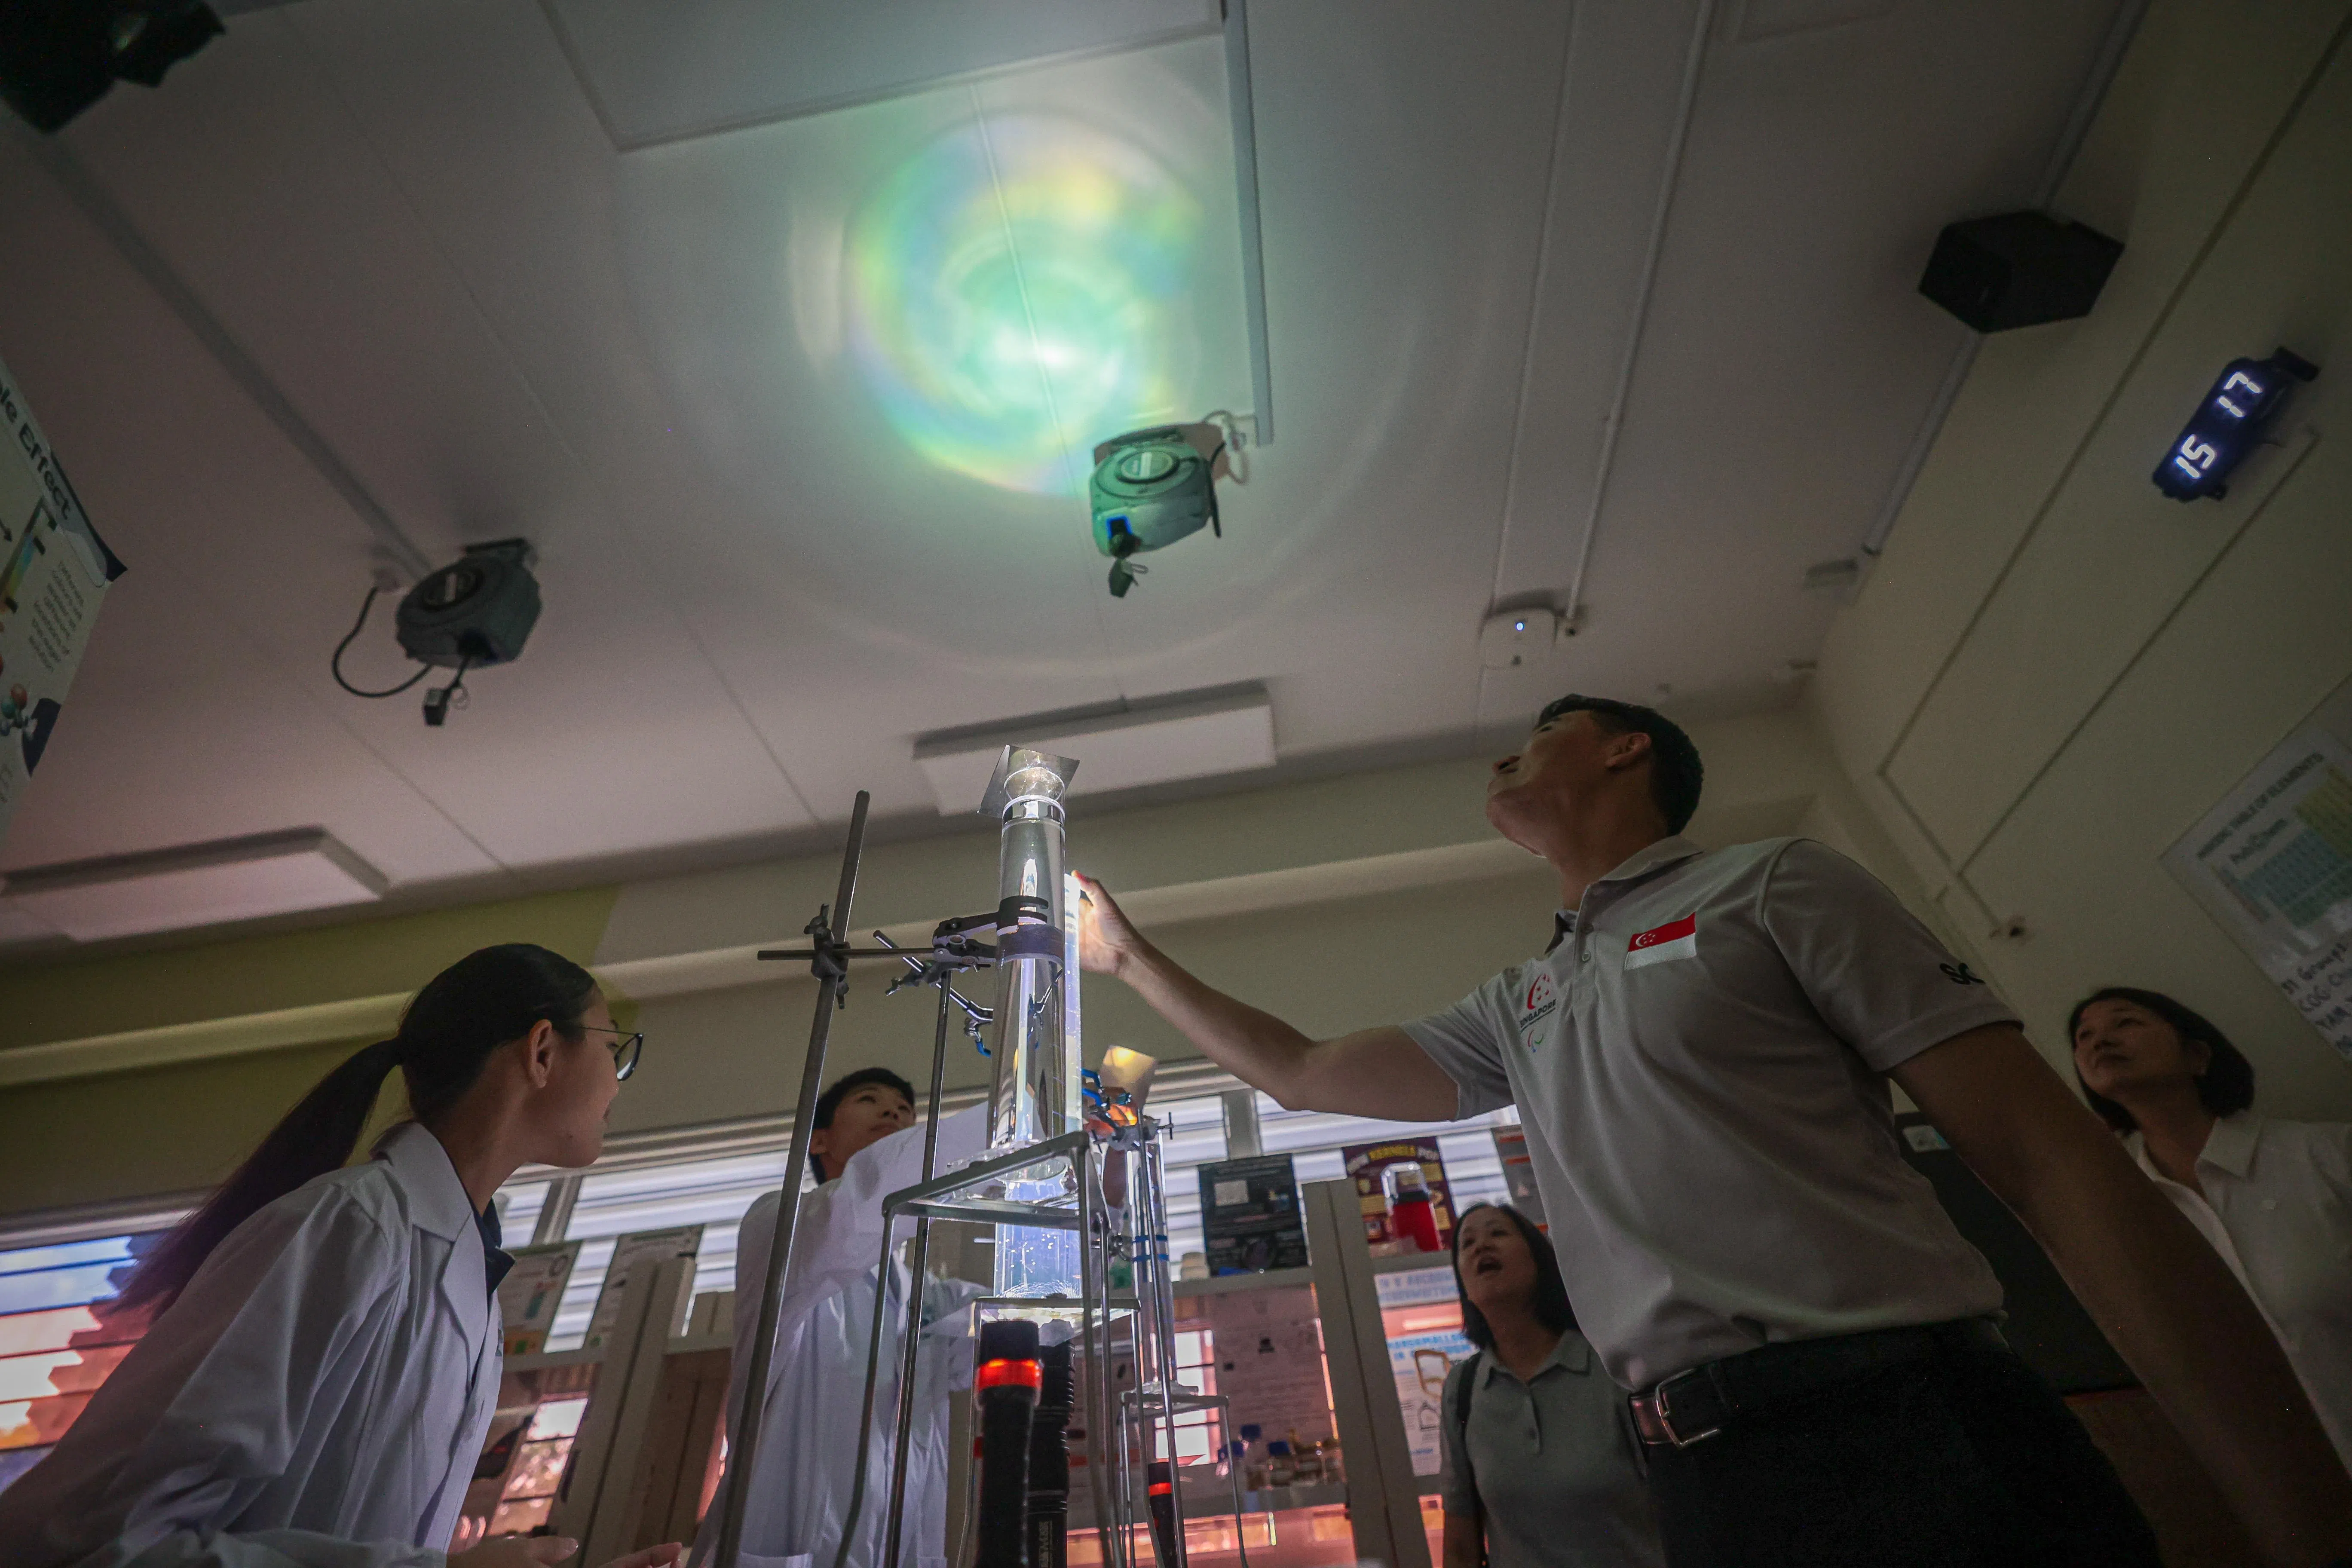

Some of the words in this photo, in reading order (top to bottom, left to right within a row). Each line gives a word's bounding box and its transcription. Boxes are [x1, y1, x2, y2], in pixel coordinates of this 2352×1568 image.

[0, 381, 18, 423] le
[19, 422, 72, 521] Effect
[2175, 434, 2216, 479] 15
[2217, 371, 2263, 418] 17
[1520, 998, 1557, 1027] SINGAPORE
